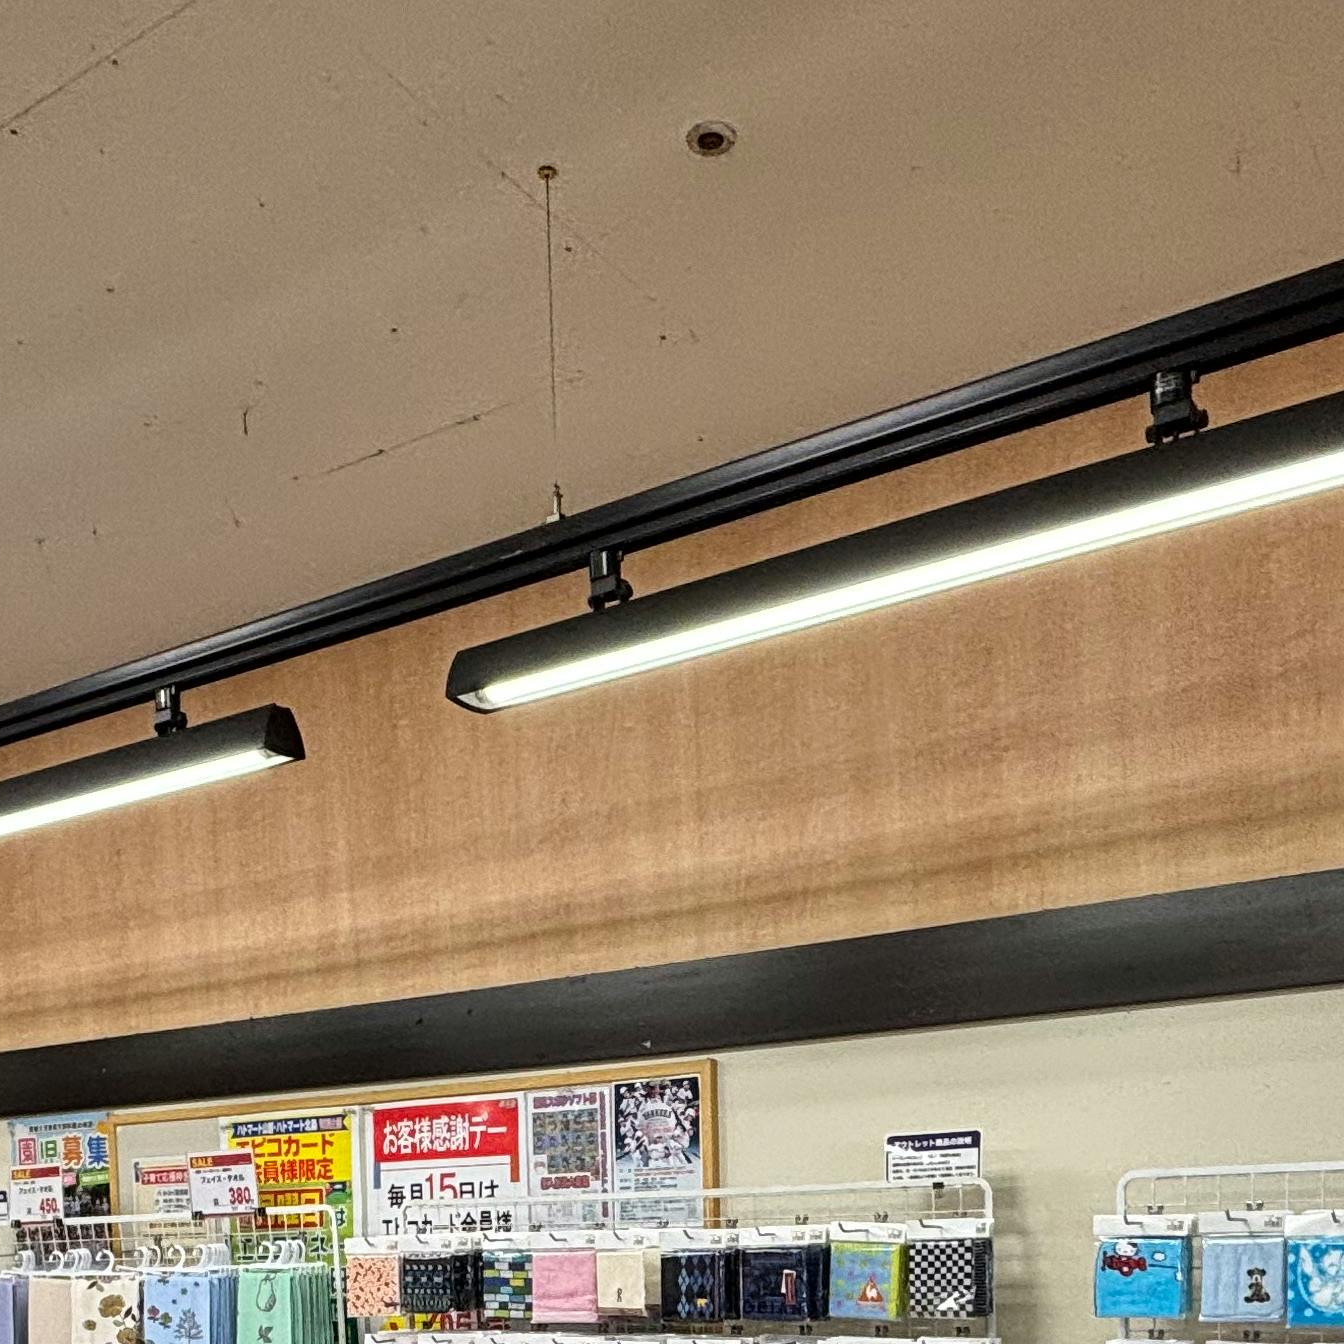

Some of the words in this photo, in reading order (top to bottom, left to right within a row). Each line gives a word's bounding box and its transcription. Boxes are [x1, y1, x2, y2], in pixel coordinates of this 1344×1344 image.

[383, 1112, 507, 1155] お客様感謝デー
[190, 1156, 213, 1168] SALE
